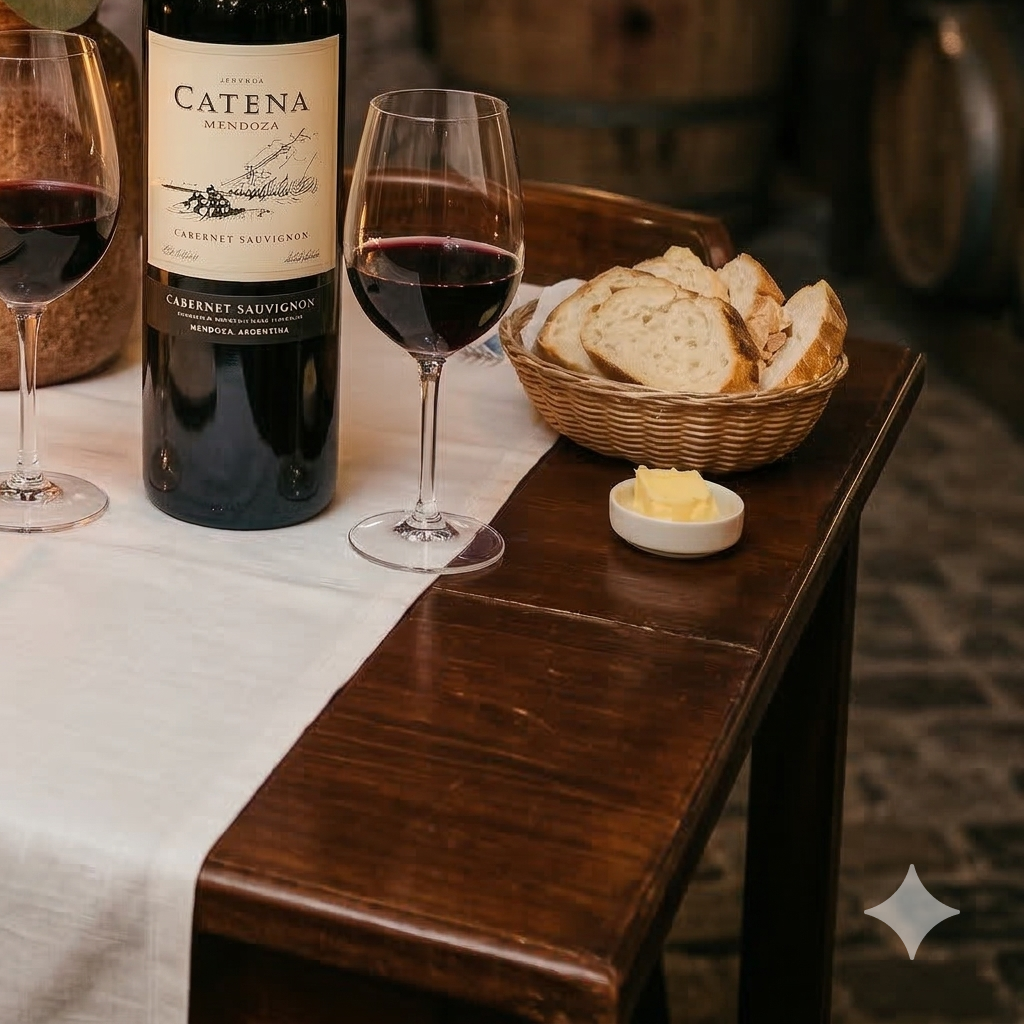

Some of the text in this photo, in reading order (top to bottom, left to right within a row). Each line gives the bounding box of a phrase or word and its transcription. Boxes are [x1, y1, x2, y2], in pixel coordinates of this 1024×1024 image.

[174, 84, 310, 114] CATENA
[204, 120, 279, 131] MENDOZA
[174, 228, 310, 244] CABERNET SAUVIGNON
[166, 294, 315, 315] CABERNET SAUVIGNON
